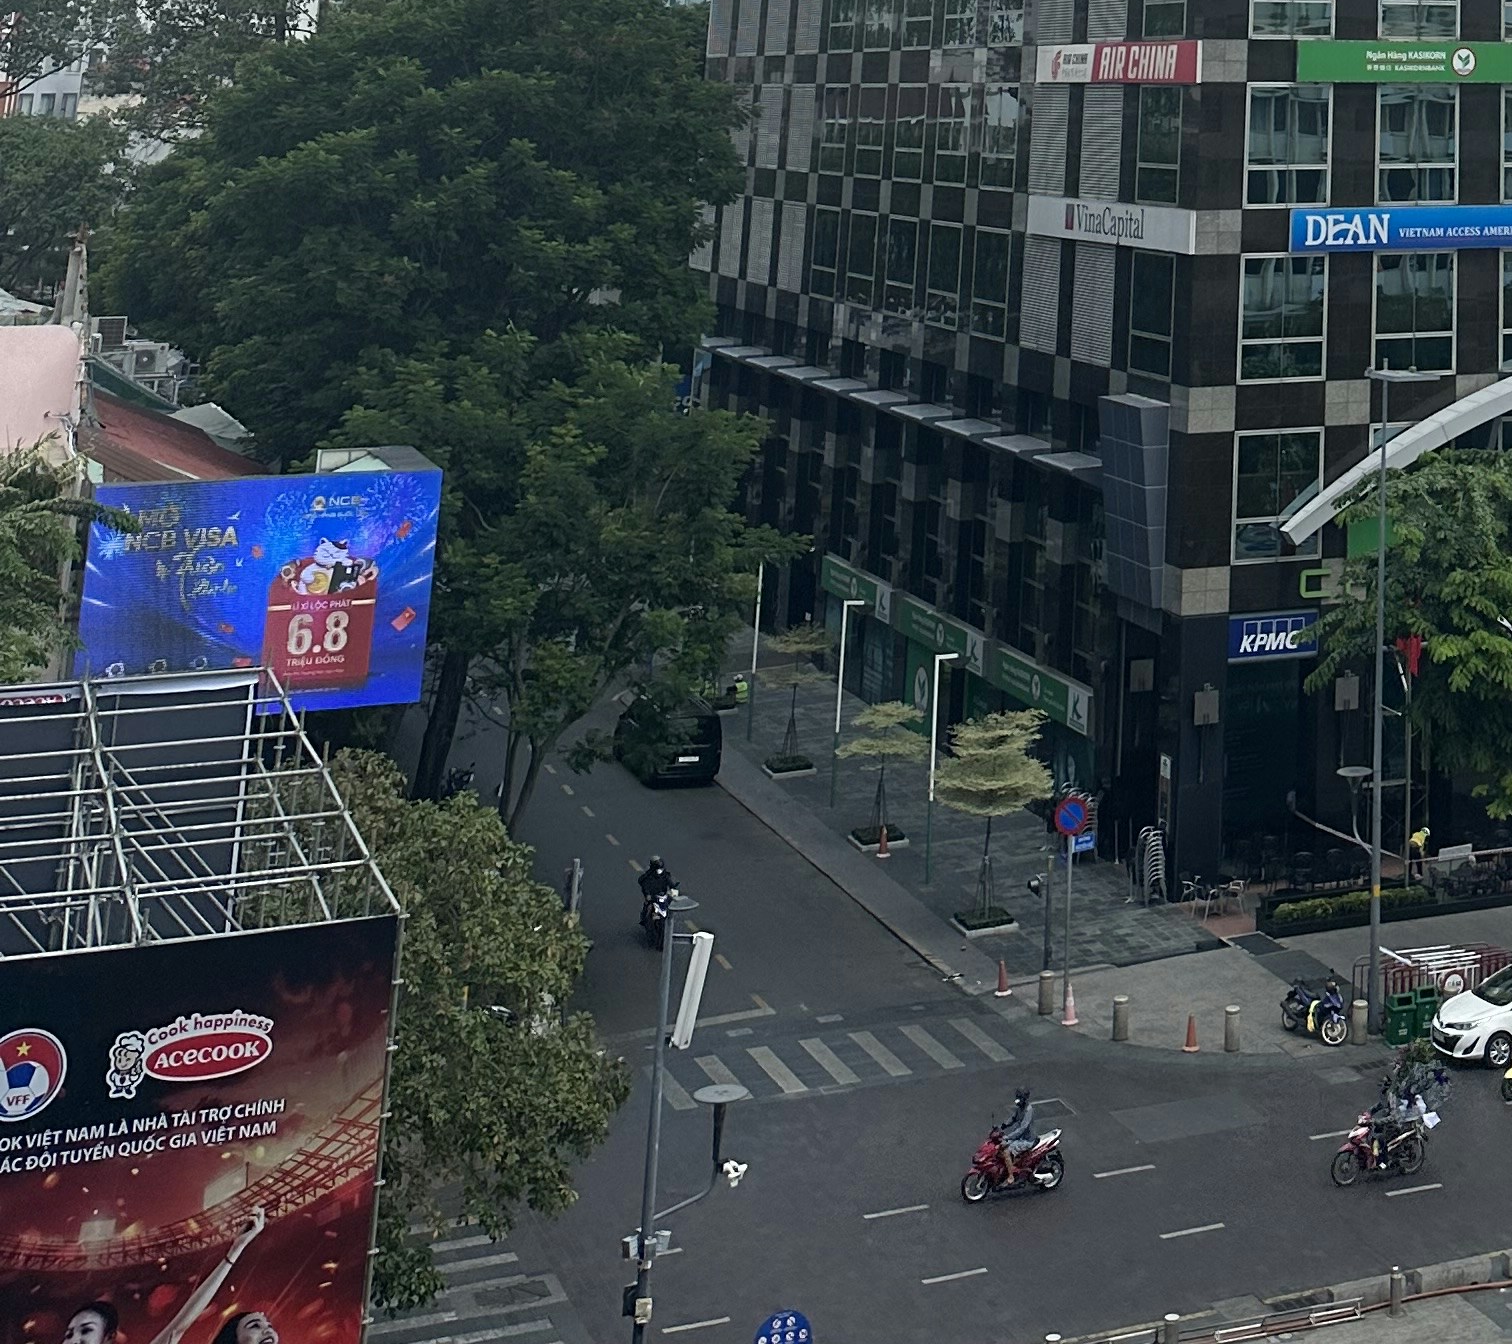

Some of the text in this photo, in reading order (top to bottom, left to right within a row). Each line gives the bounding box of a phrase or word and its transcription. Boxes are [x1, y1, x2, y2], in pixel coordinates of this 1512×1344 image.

[1098, 44, 1178, 80] AIR CHINA
[1408, 51, 1446, 60] KASIKORN
[1076, 204, 1145, 244] VinaCapital
[1304, 213, 1390, 246] DEAN
[1399, 227, 1444, 238] VIETNAM
[1446, 226, 1481, 237] ACCESS
[124, 525, 239, 551] NCB VISA
[287, 610, 350, 655] 6.8
[148, 1012, 271, 1045] Cook happiness
[6, 1093, 31, 1107] VFF
[25, 1129, 62, 1151] VIỆT
[65, 1124, 105, 1145] NAM
[108, 1118, 129, 1138] LÀ
[132, 1112, 168, 1134] NHÀ
[170, 1107, 197, 1128] TÀI
[199, 1104, 234, 1124] TRỢ
[234, 1097, 286, 1120] CHÍNH
[25, 1151, 59, 1173] ĐỘI
[118, 1134, 167, 1158] QUỐC
[169, 1129, 198, 1150] GIA
[200, 1124, 237, 1147] VIỆT
[238, 1120, 278, 1141] NAM
